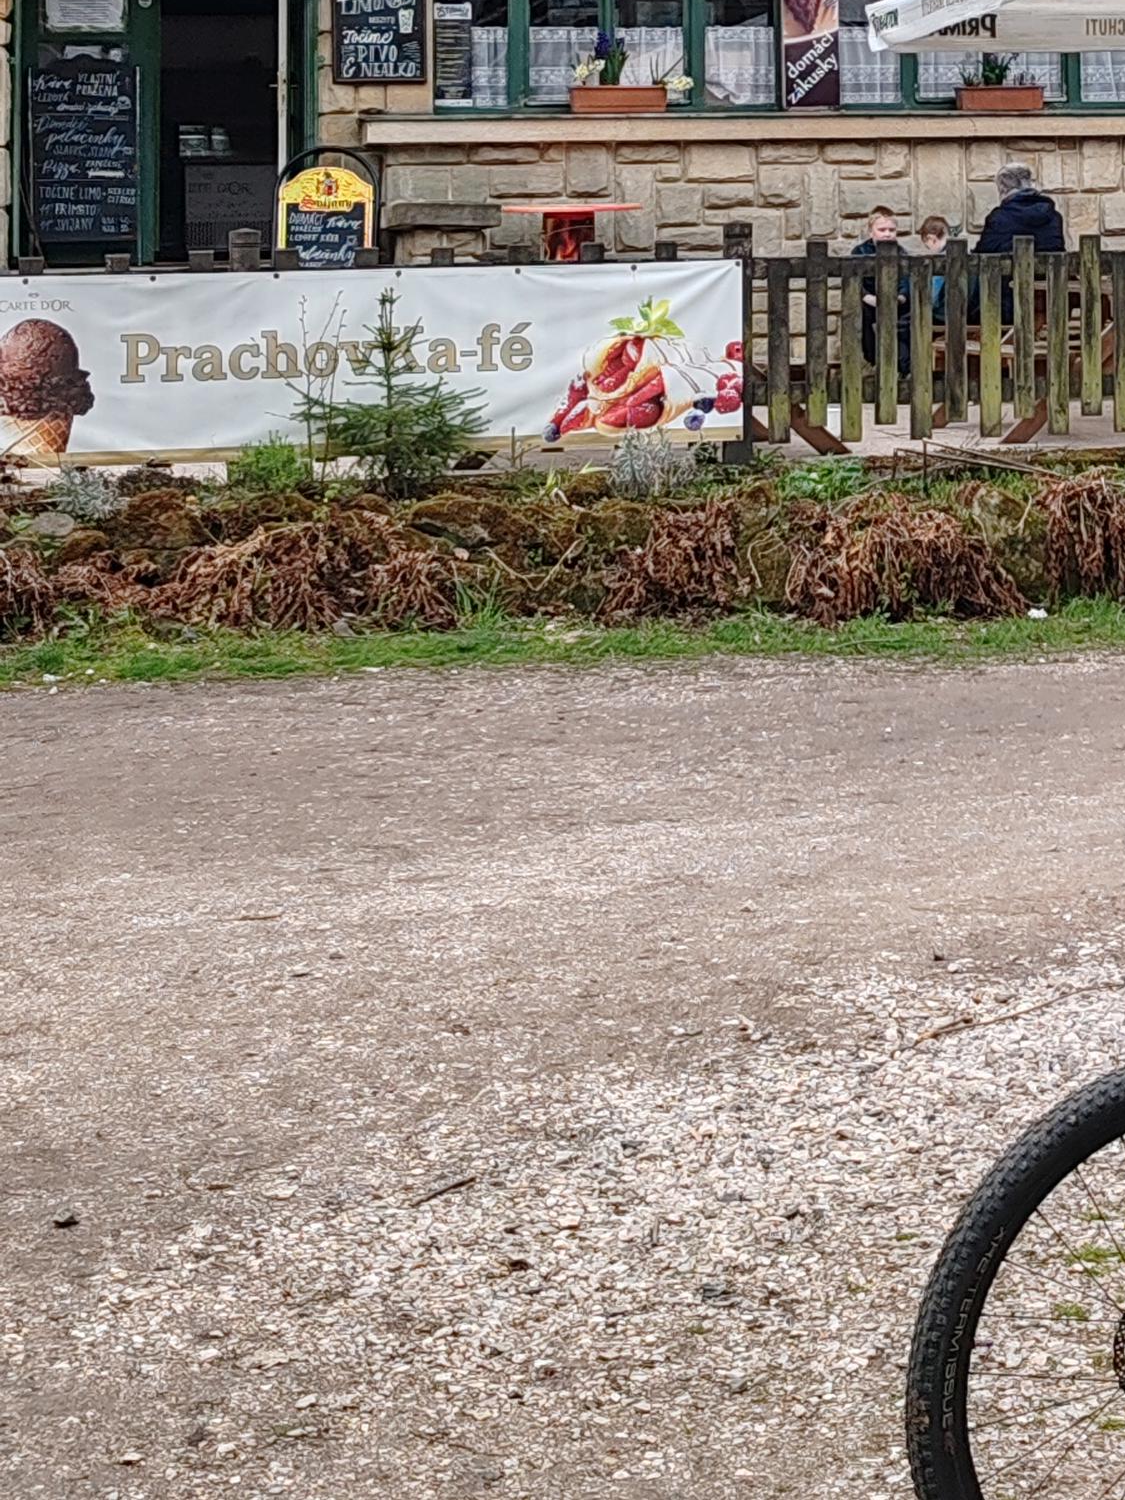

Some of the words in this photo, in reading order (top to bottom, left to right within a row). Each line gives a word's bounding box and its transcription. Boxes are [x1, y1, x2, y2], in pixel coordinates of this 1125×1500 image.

[357, 45, 398, 62] PIVO
[787, 53, 838, 105] zákusky
[0, 300, 36, 313] CARTE
[41, 299, 75, 312] D'OR
[947, 1285, 981, 1353] TEAM
[940, 1354, 960, 1431] ISSUE
